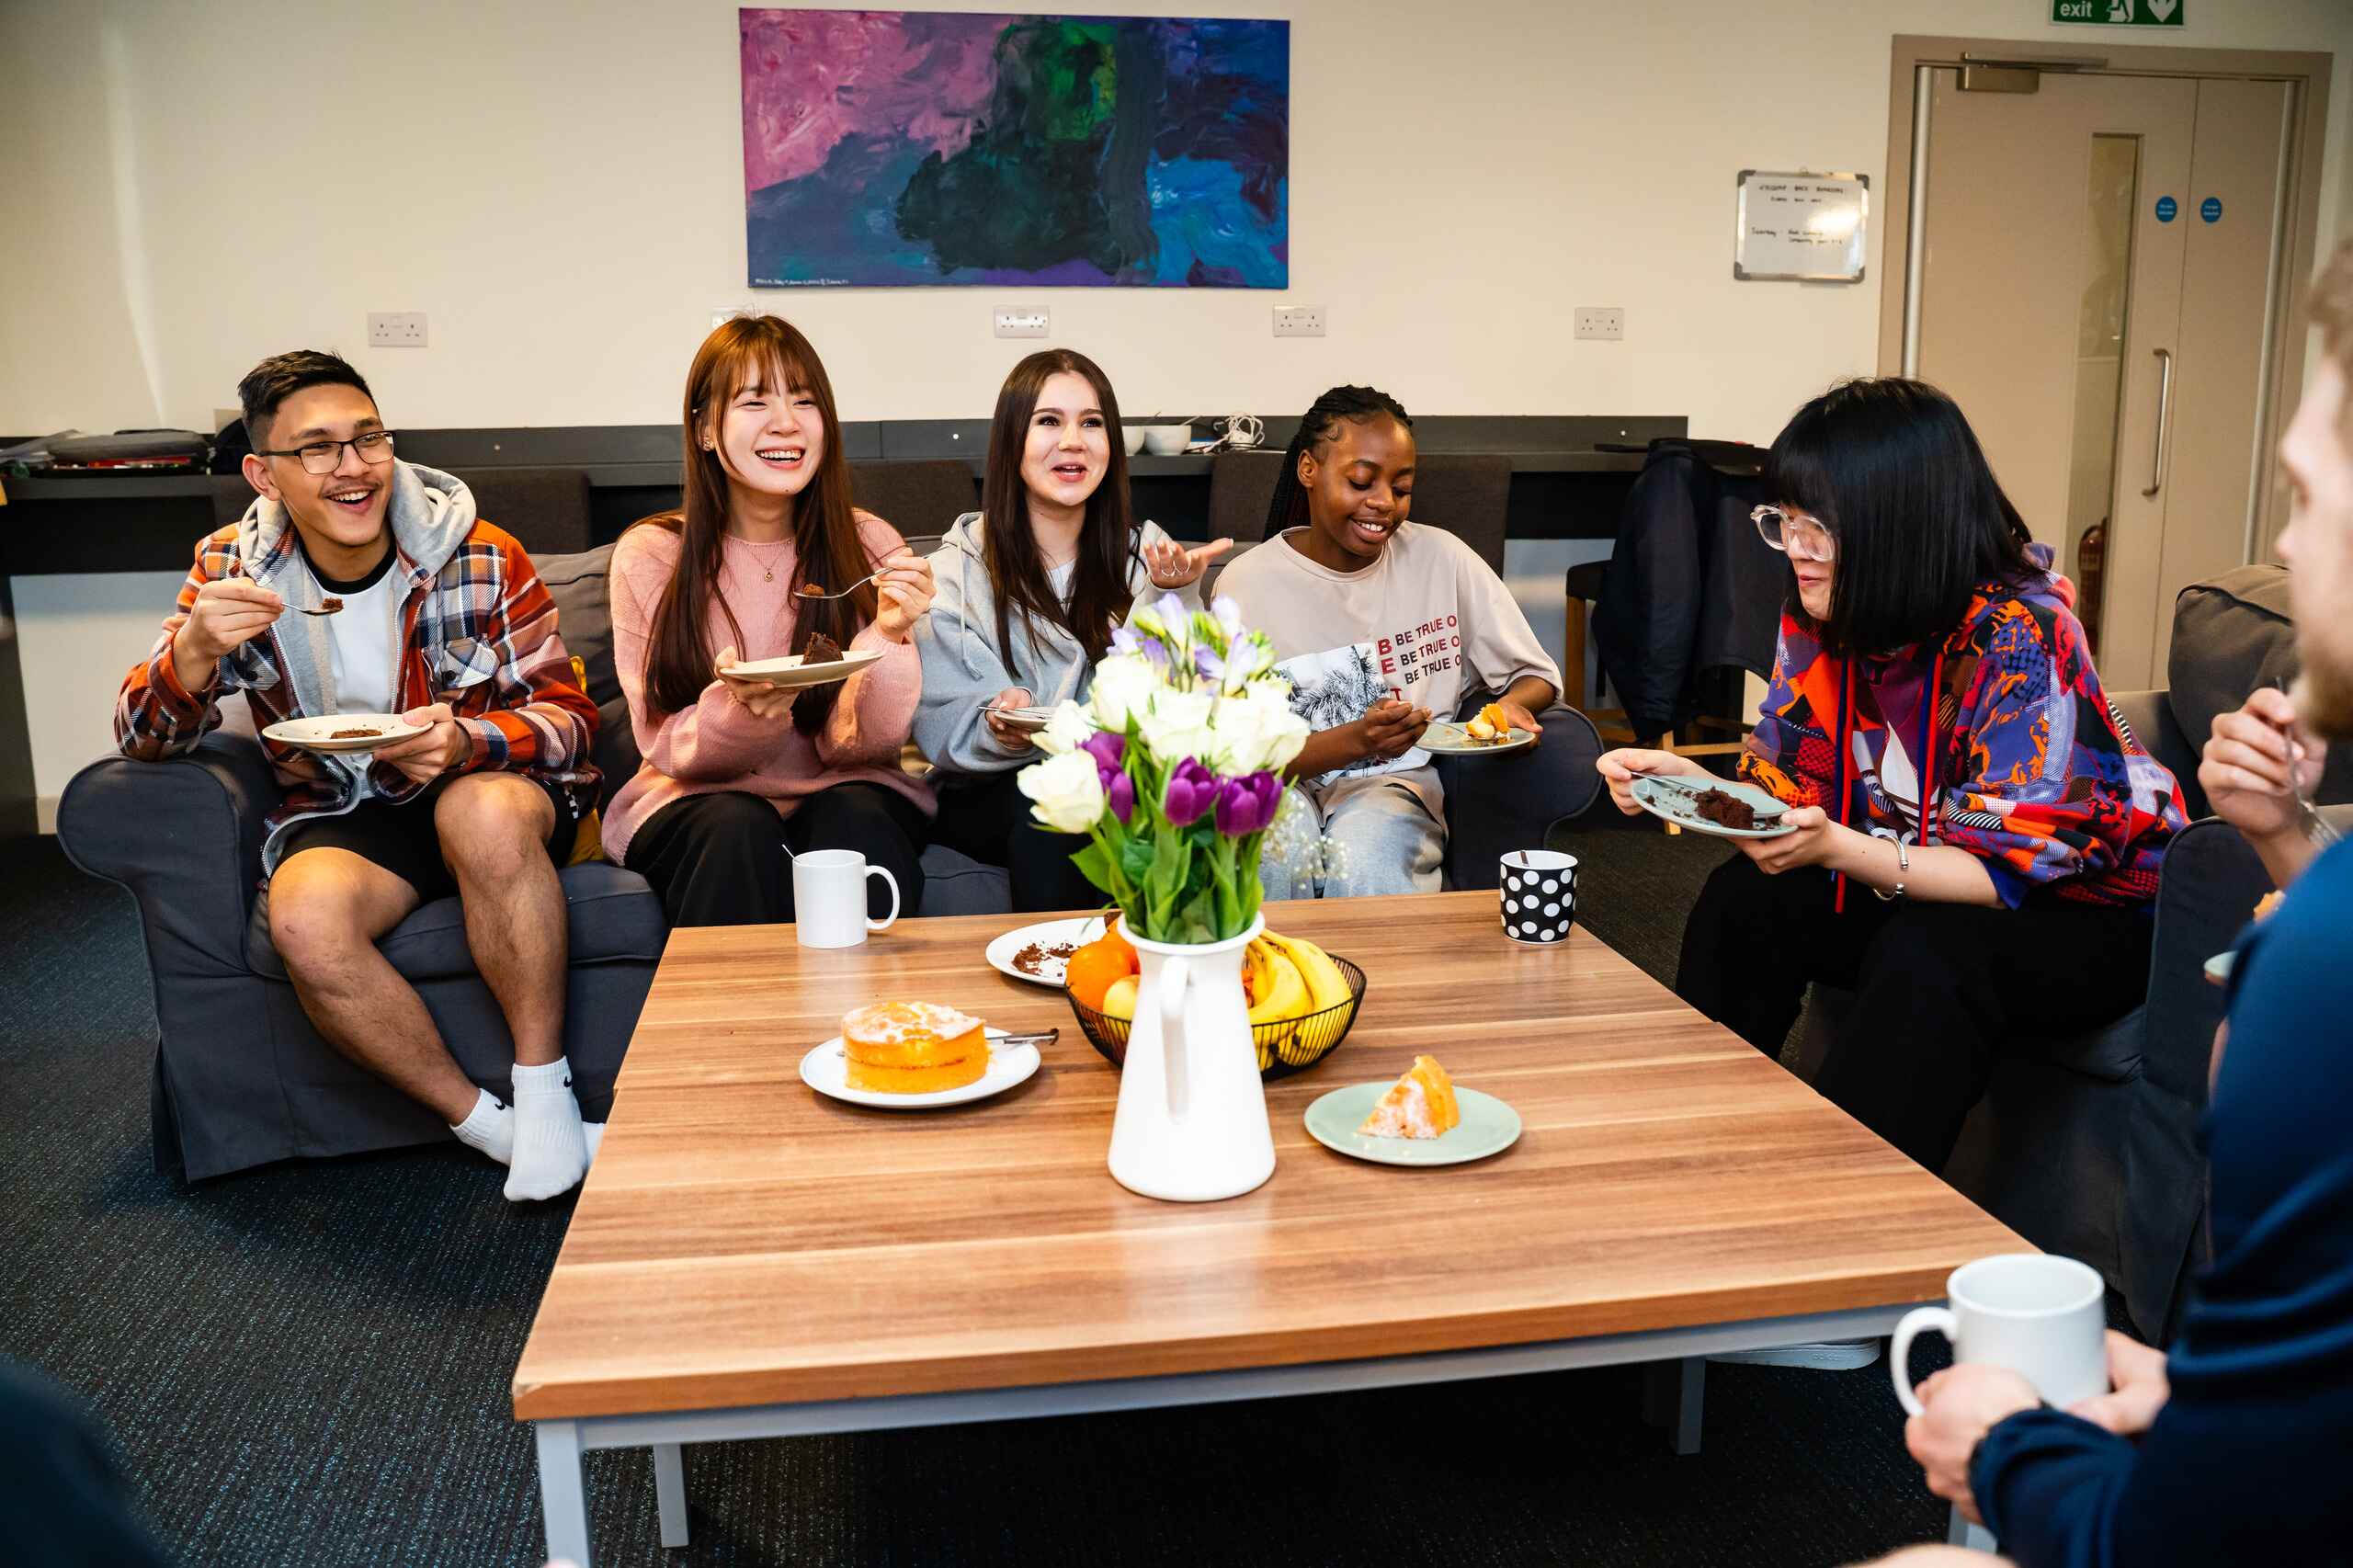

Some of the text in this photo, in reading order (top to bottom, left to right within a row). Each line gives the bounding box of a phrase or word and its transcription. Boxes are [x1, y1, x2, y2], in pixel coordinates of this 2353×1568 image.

[2060, 1, 2093, 17] exit
[1395, 631, 1414, 646] BE
[1415, 618, 1443, 638] TRUE
[1400, 651, 1418, 666] BE
[1418, 639, 1448, 657] TRUE
[1404, 669, 1420, 685] BE
[1422, 658, 1451, 676] TRUE
